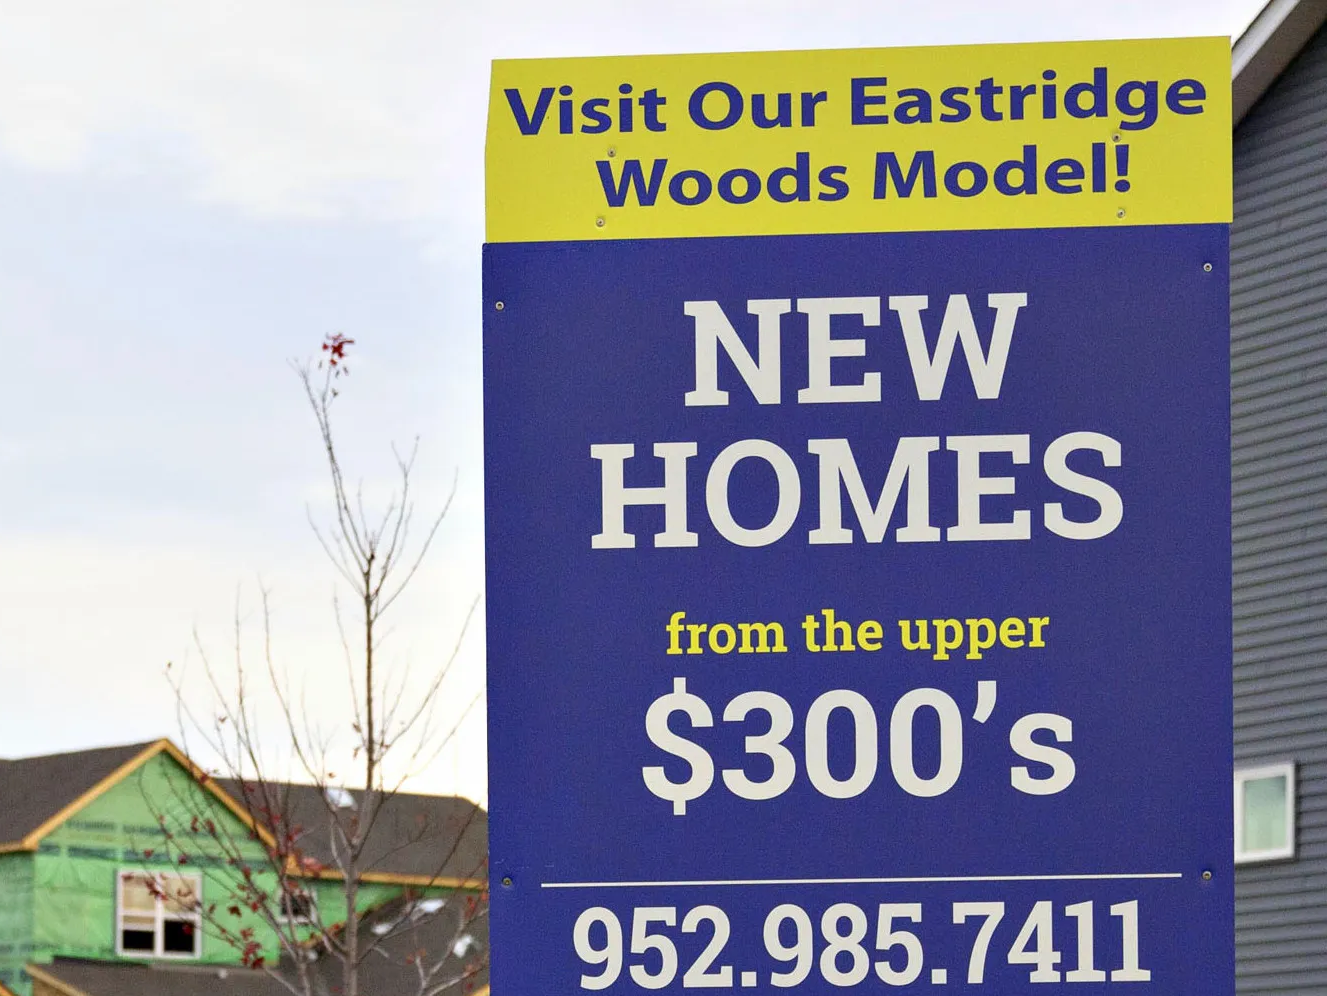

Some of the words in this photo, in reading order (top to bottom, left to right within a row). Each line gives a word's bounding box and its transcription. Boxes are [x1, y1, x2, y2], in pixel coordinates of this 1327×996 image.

[506, 85, 665, 134] Visit
[690, 83, 826, 129] Our
[852, 68, 1205, 129] Eastridge
[597, 153, 848, 206] Woods
[874, 143, 1129, 198] Model!
[684, 293, 1027, 406] NEW
[591, 432, 1123, 548] HOMES
[666, 612, 787, 654] from
[802, 609, 883, 652] the
[899, 617, 1049, 660] upper
[643, 678, 1075, 815] $300’s
[574, 900, 1150, 989] 952.985.7411
